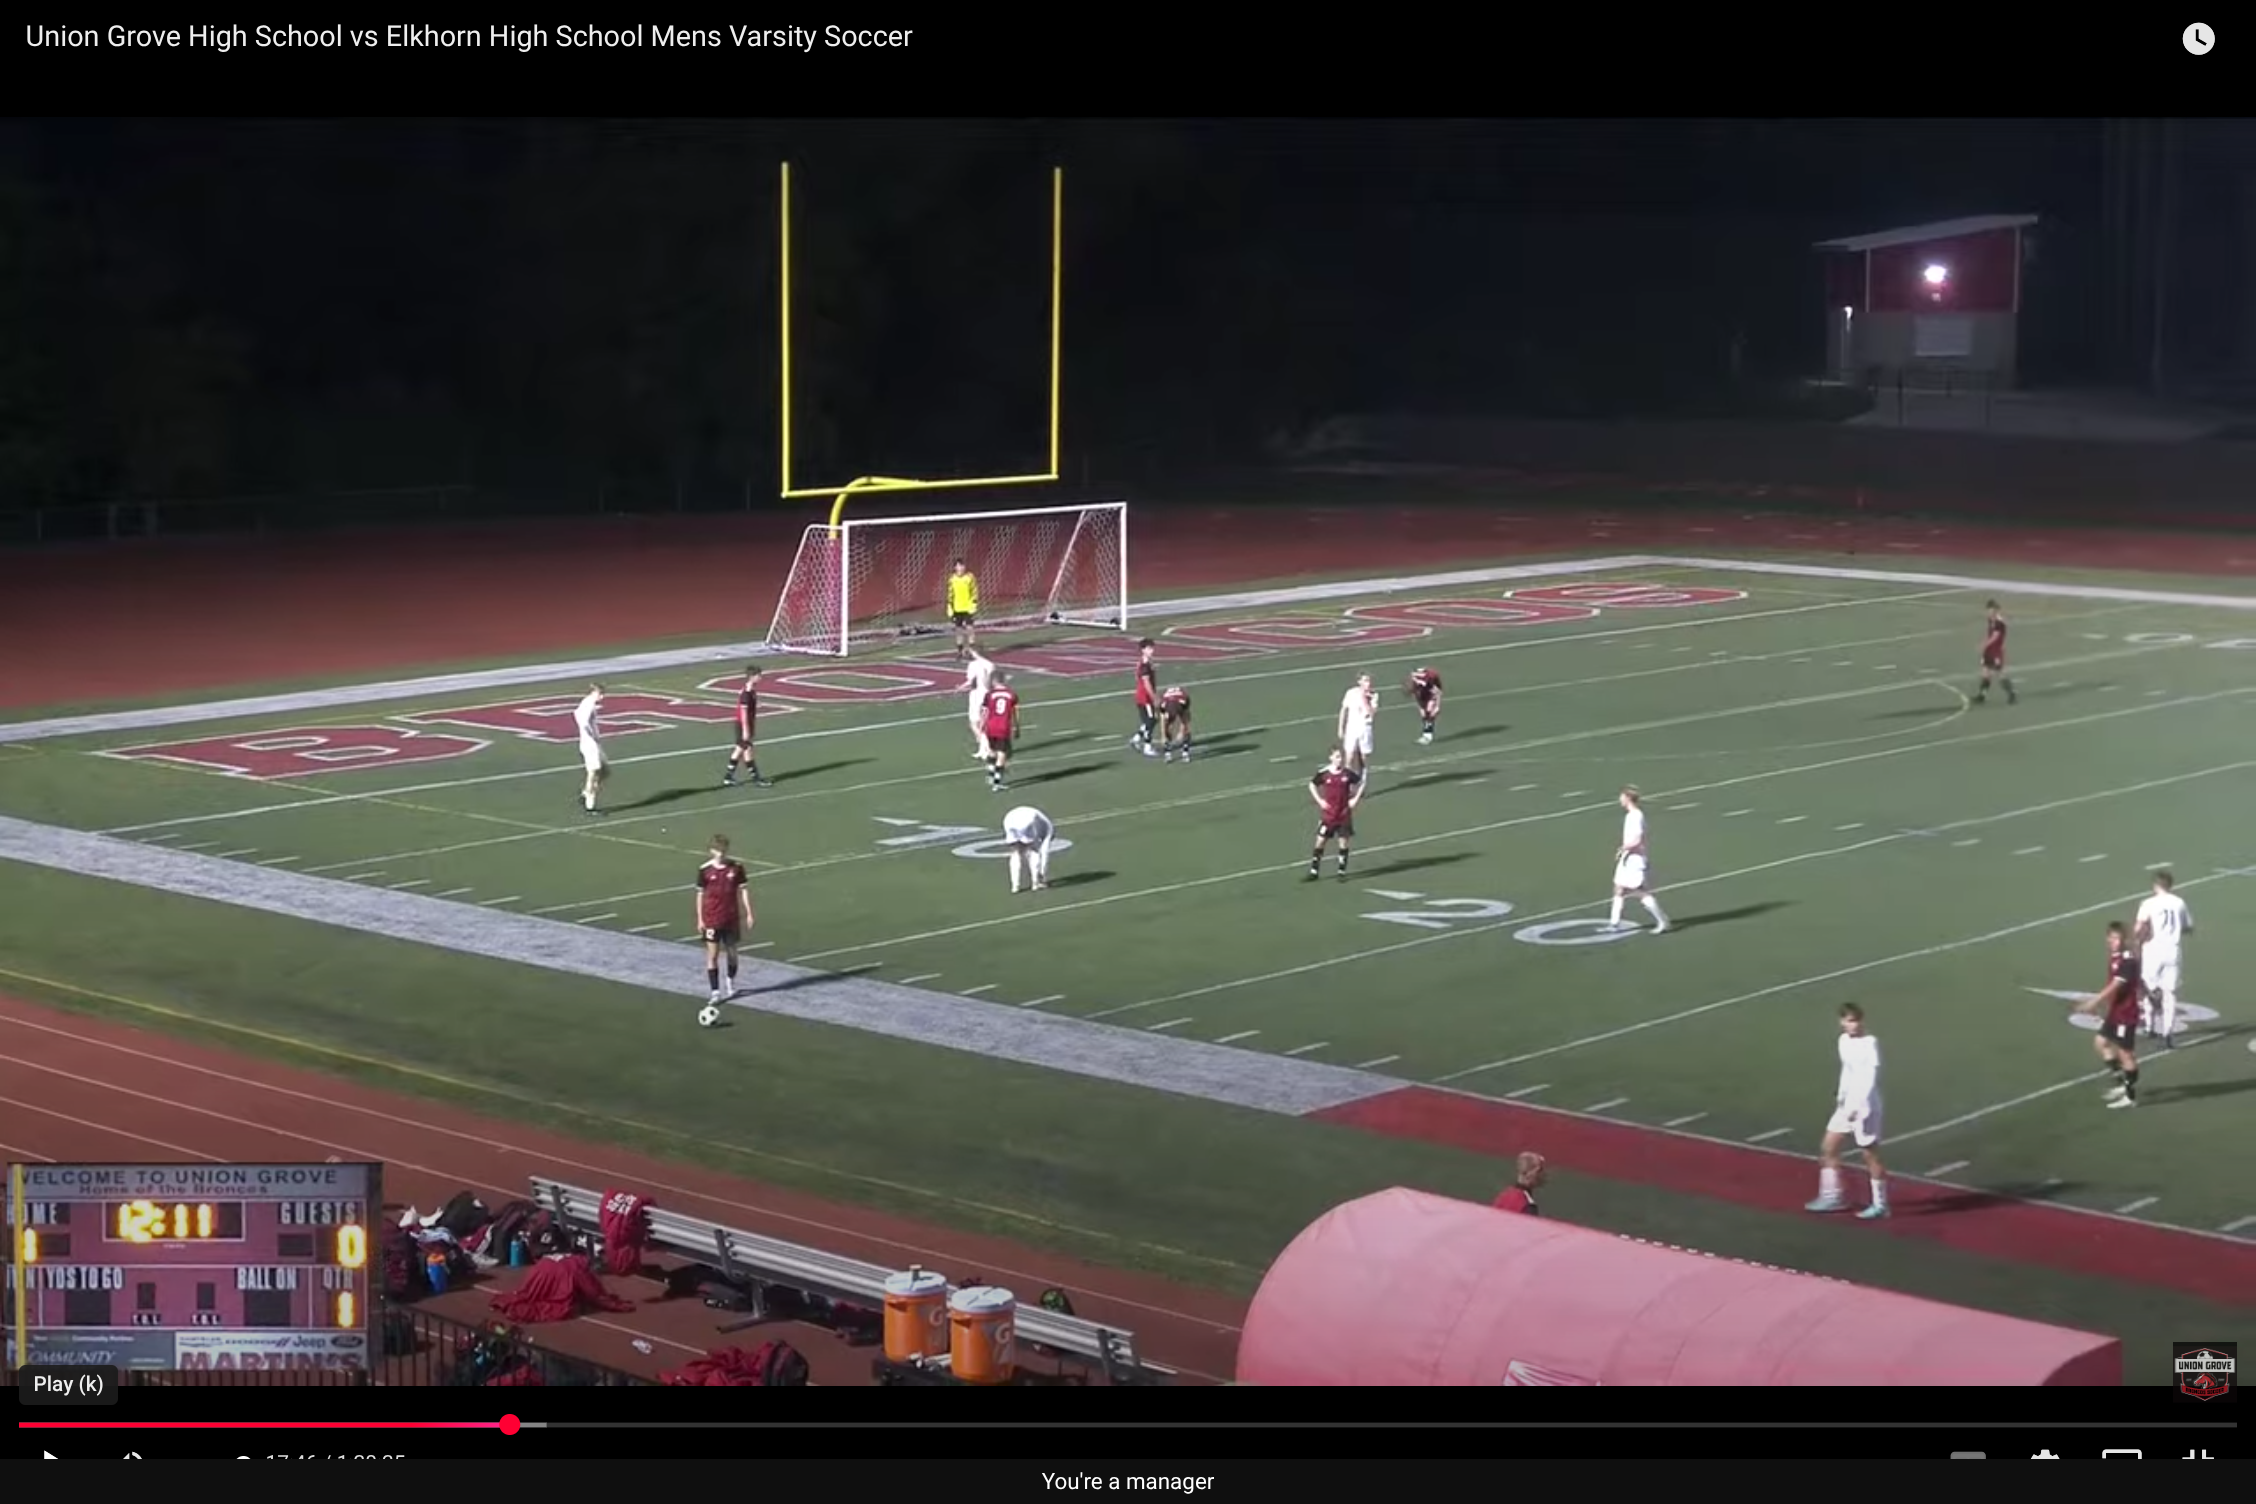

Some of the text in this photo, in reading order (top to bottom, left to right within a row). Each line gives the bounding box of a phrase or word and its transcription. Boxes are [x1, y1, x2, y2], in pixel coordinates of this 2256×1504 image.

[137, 1170, 165, 1185] TO
[176, 1169, 247, 1184] UNION
[257, 1169, 338, 1184] GROVE
[281, 1201, 356, 1225] GUESTS
[337, 1224, 367, 1268] 0
[237, 1267, 297, 1290] BALL ON
